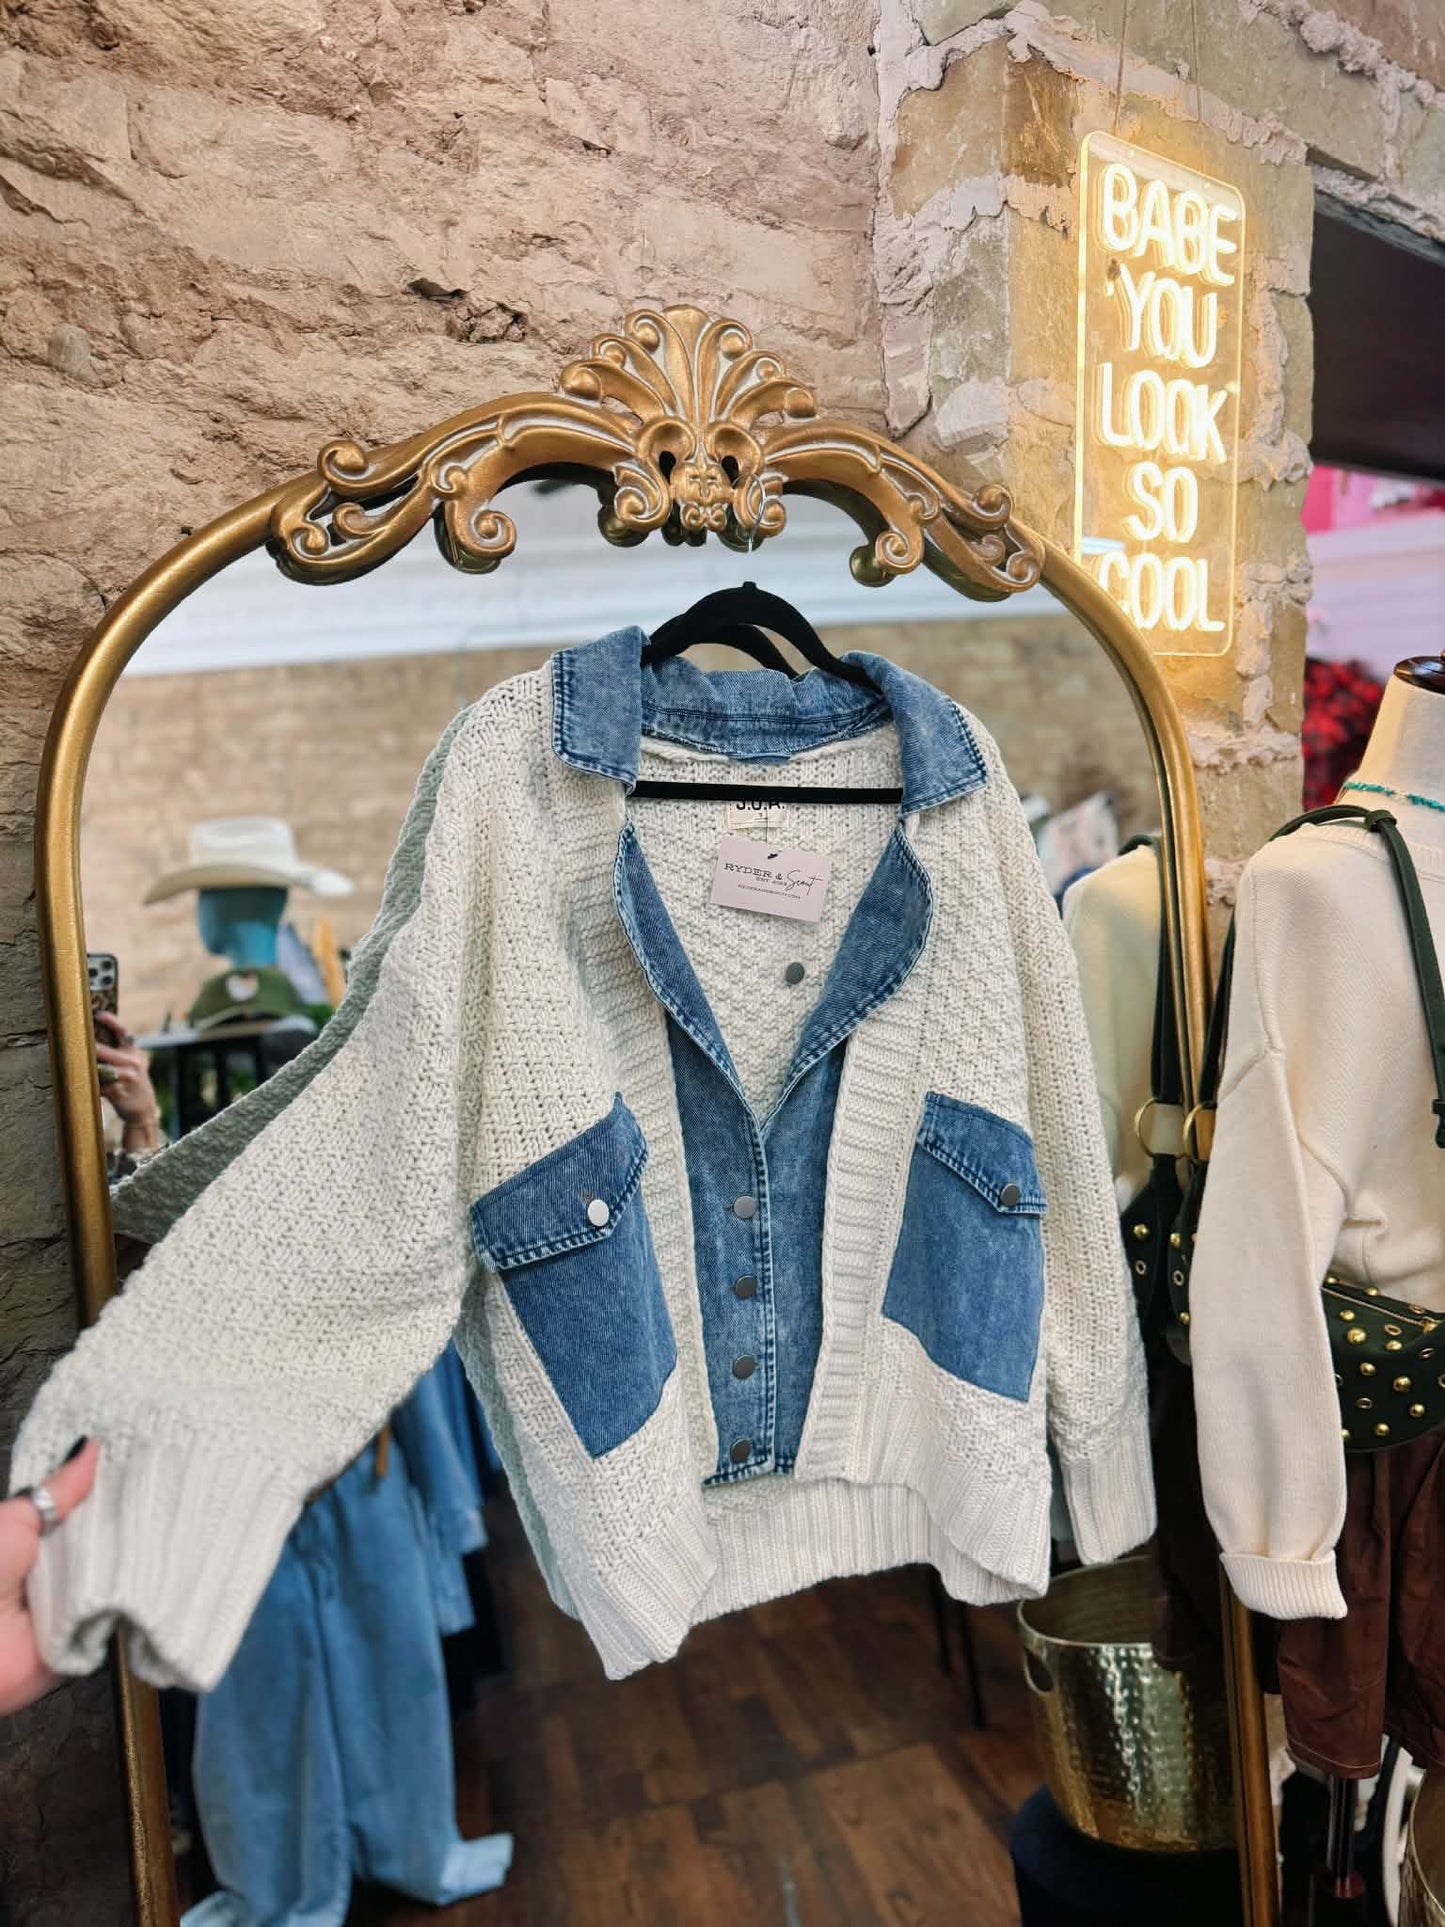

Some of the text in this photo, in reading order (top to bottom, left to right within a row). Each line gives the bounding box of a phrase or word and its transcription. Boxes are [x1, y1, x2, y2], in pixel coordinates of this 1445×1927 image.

[1099, 162, 1238, 286] BABE
[1116, 262, 1219, 369] YOU
[1098, 361, 1229, 464] LOOK
[1122, 460, 1200, 544] SO
[723, 862, 773, 879] RYDER
[775, 873, 784, 881] &
